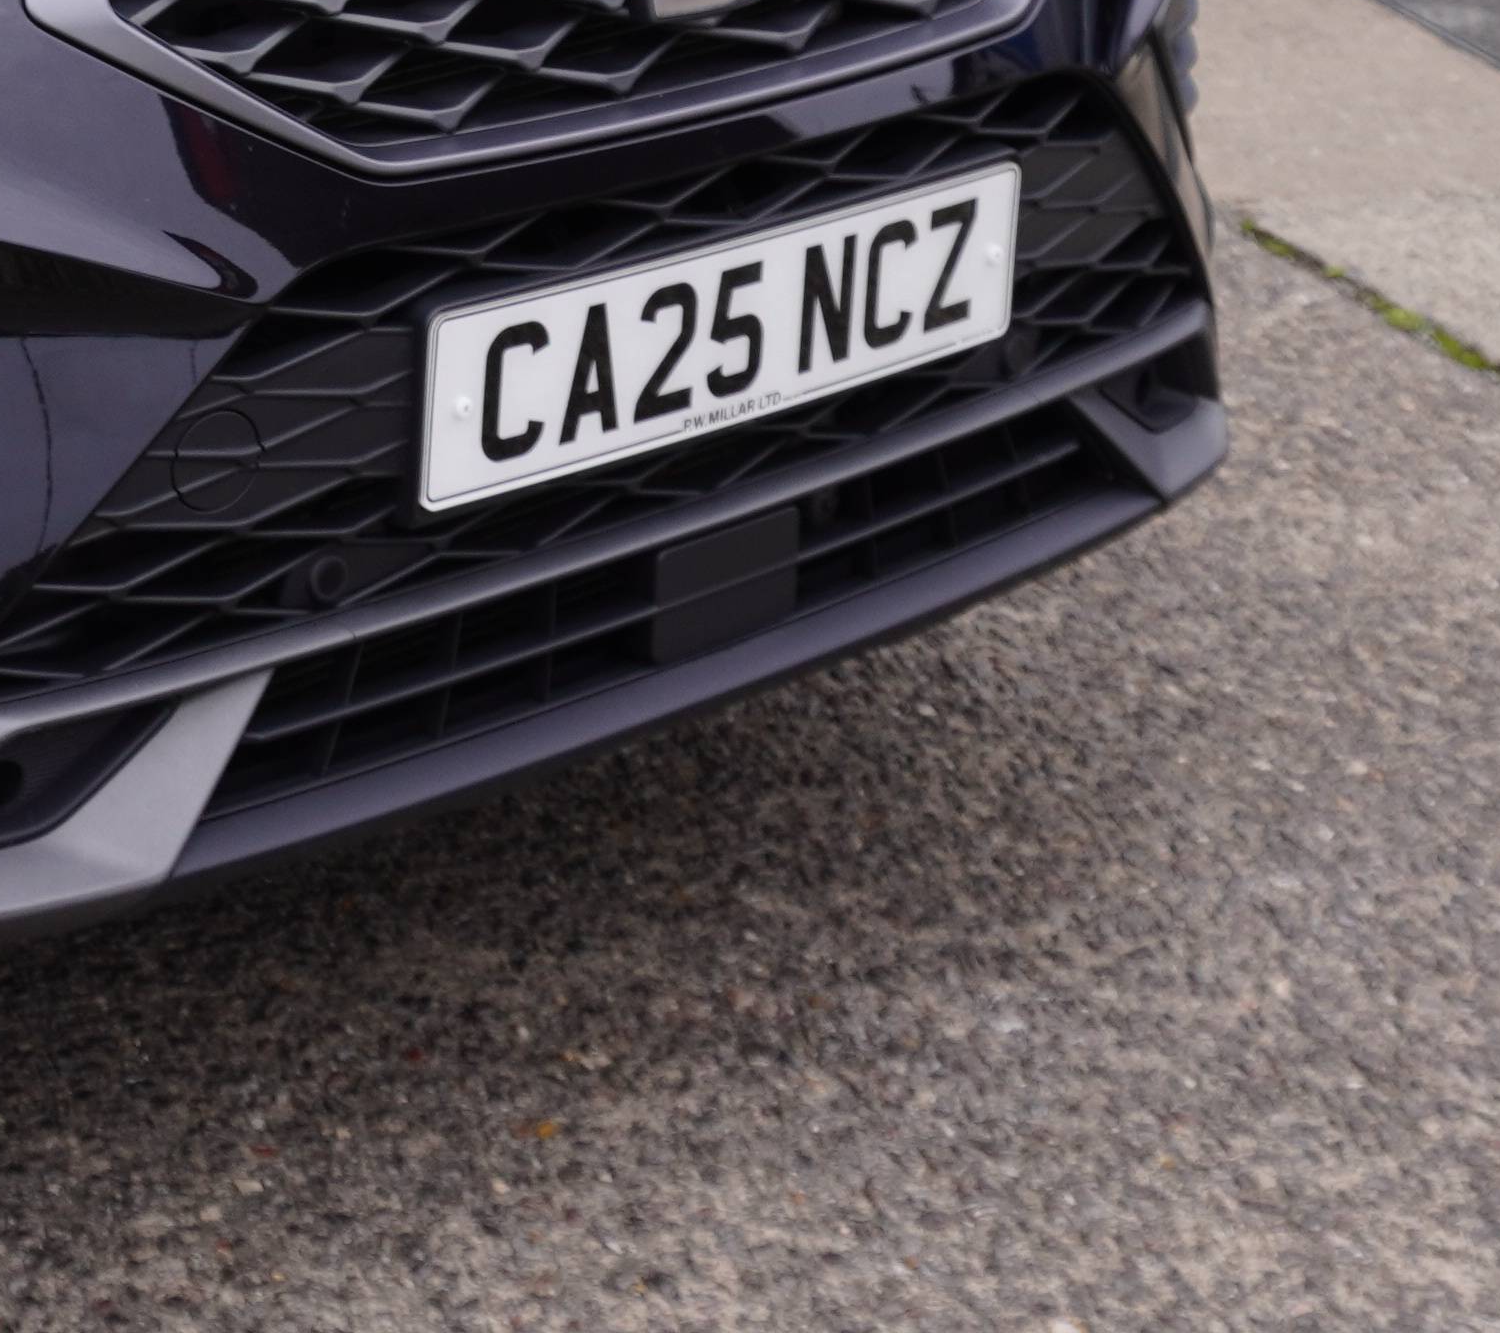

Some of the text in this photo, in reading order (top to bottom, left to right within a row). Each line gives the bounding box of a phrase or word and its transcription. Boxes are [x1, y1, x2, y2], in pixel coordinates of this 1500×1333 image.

[480, 197, 979, 463] CA25 NCZ
[759, 391, 782, 410] LTD
